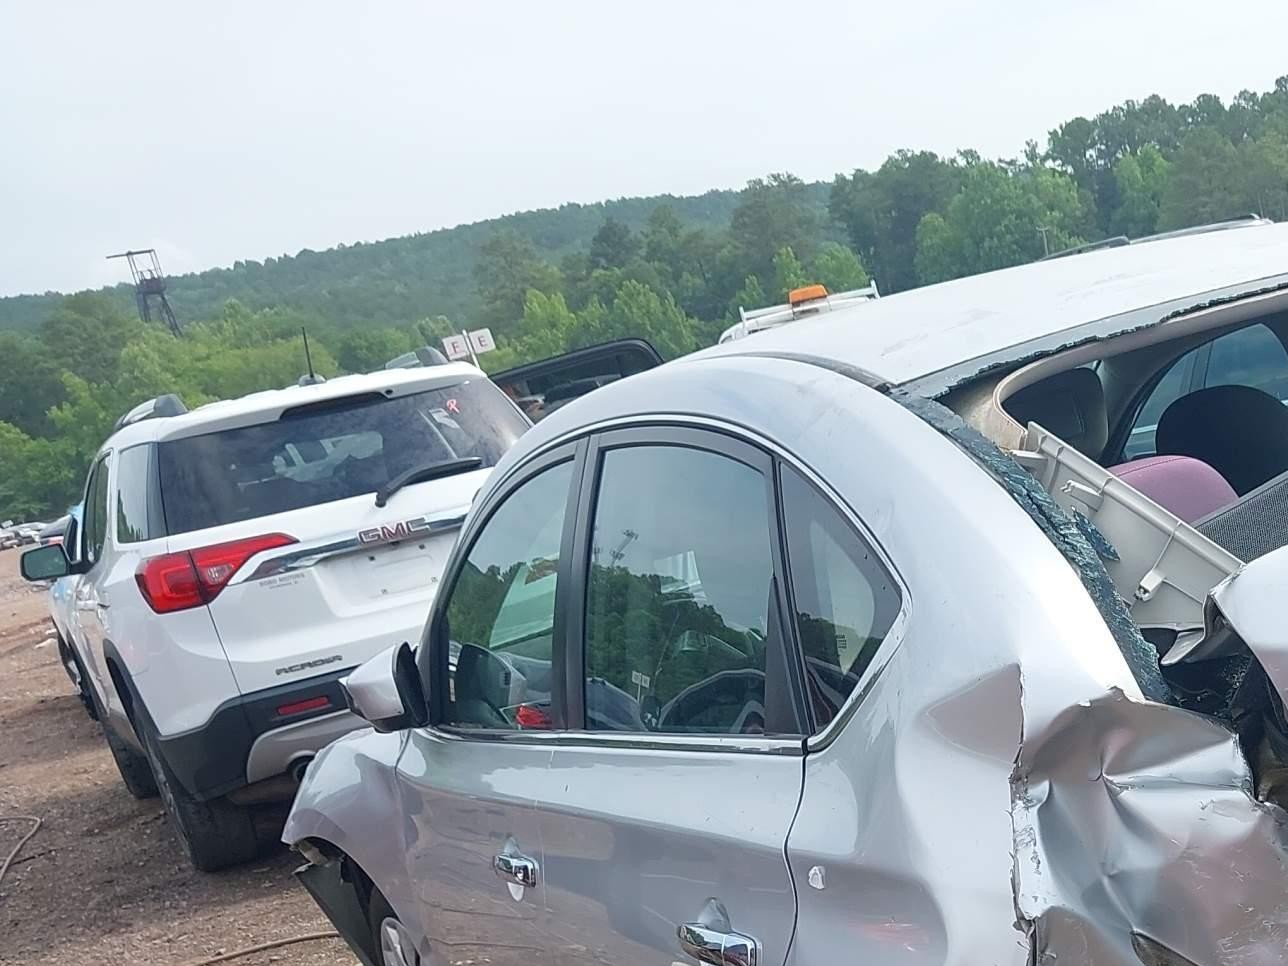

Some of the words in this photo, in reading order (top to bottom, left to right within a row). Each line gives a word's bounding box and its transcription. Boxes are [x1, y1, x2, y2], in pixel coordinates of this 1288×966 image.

[450, 341, 460, 354] F
[477, 335, 489, 348] E
[357, 515, 431, 544] GMC
